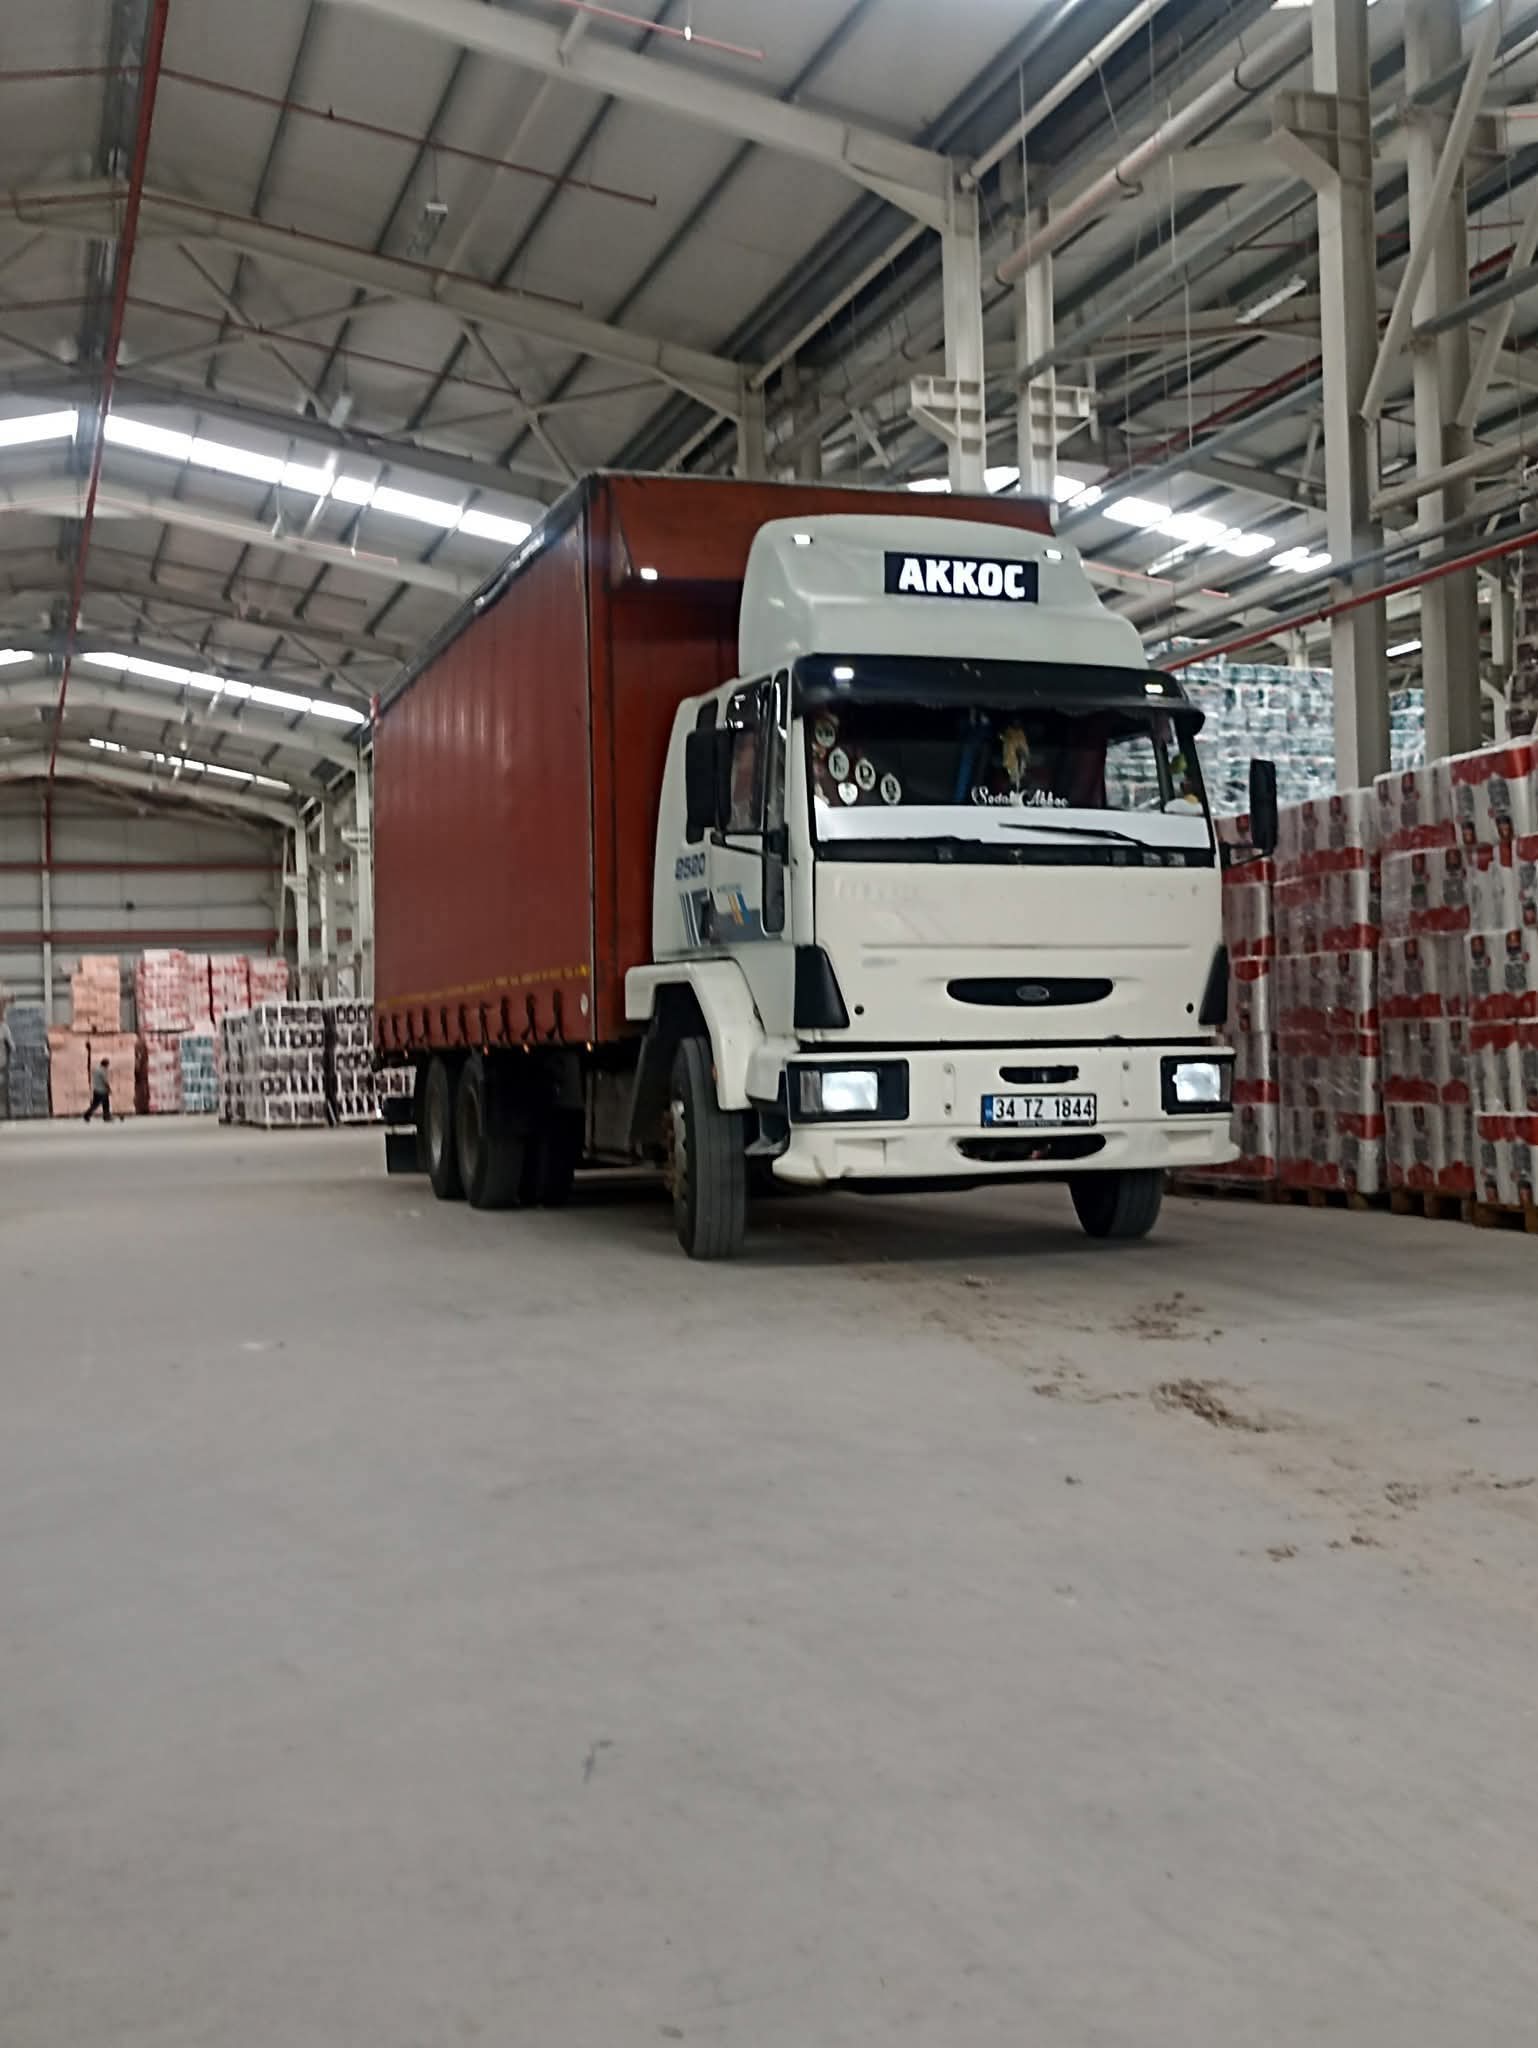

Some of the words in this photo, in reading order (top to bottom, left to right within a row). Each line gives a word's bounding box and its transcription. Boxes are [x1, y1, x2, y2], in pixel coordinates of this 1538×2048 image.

[995, 1098, 1015, 1119] 34
[1023, 1098, 1043, 1118] TZ
[1054, 1098, 1092, 1118] 1844
